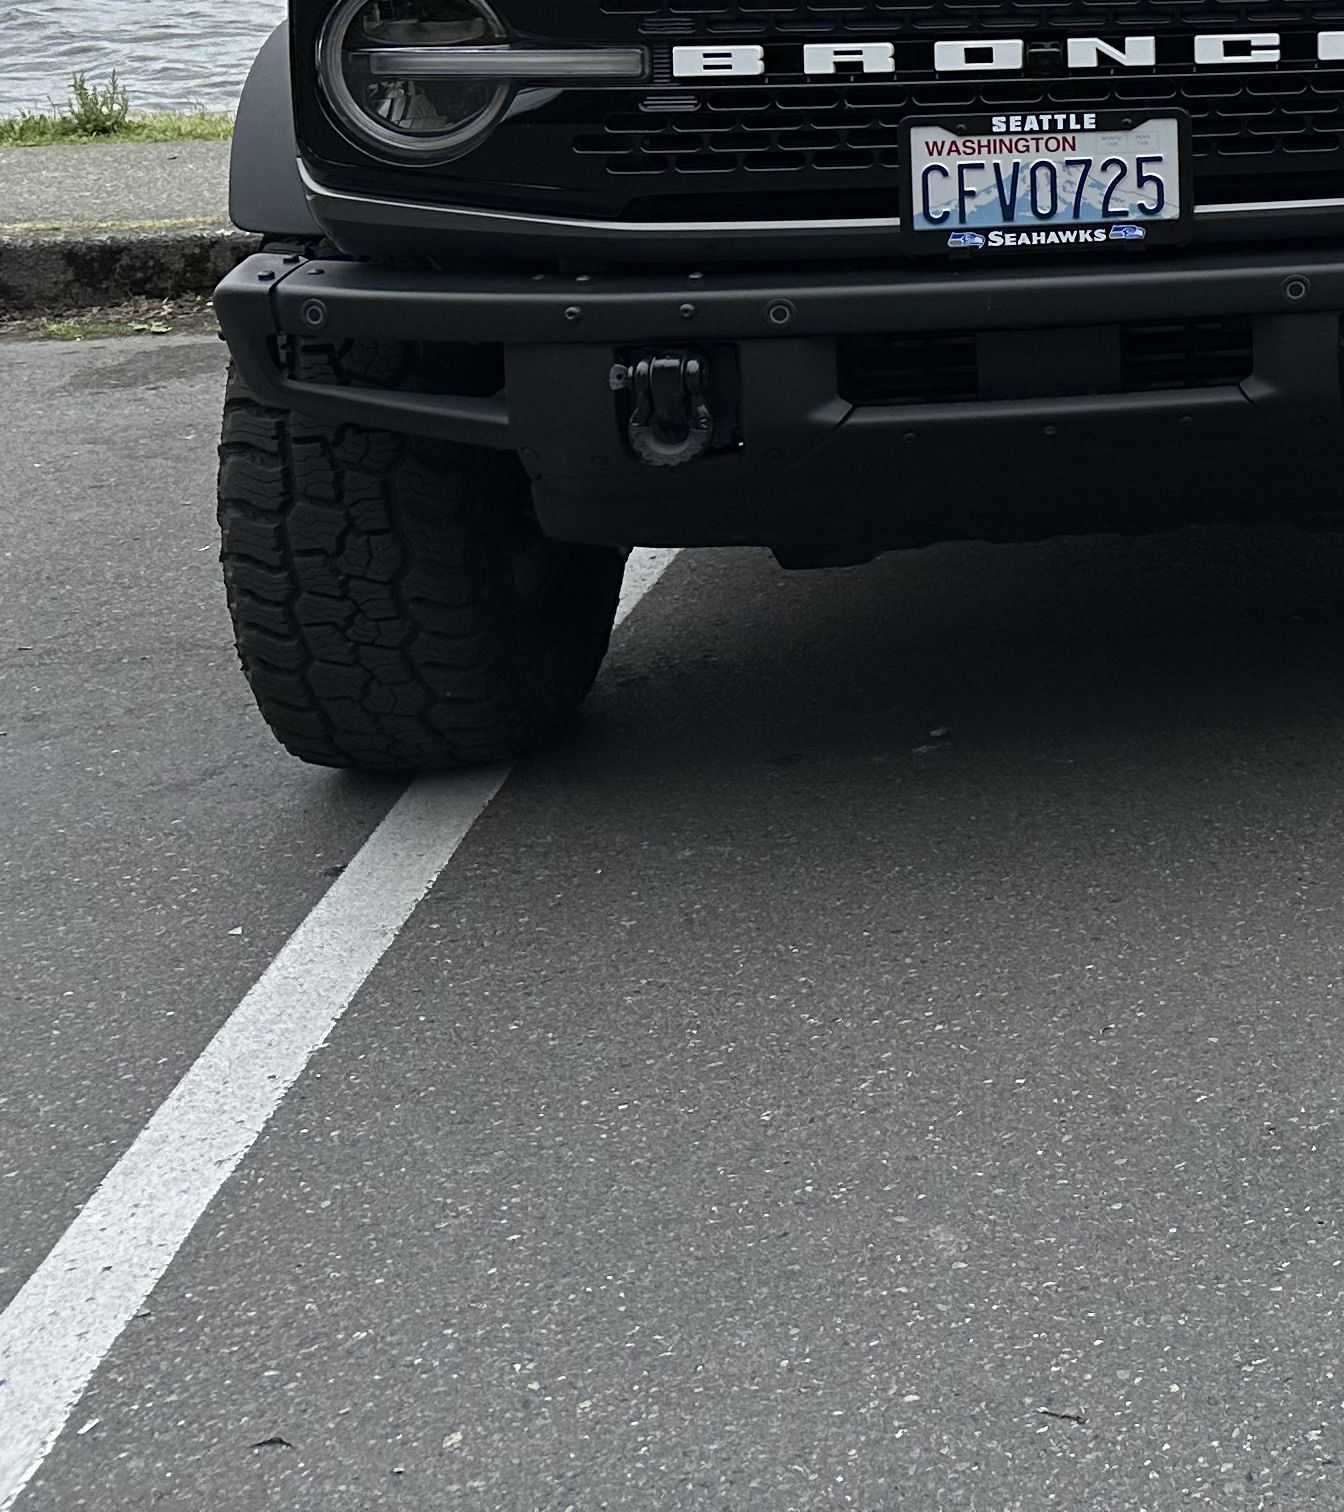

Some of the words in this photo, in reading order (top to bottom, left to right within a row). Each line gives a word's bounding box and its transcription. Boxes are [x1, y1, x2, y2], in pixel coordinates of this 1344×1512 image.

[991, 113, 1097, 133] SEATTLE
[924, 136, 1077, 157] WASHINGTON
[921, 155, 1166, 225] CFV0725
[987, 228, 1107, 248] SEAHAWKS
